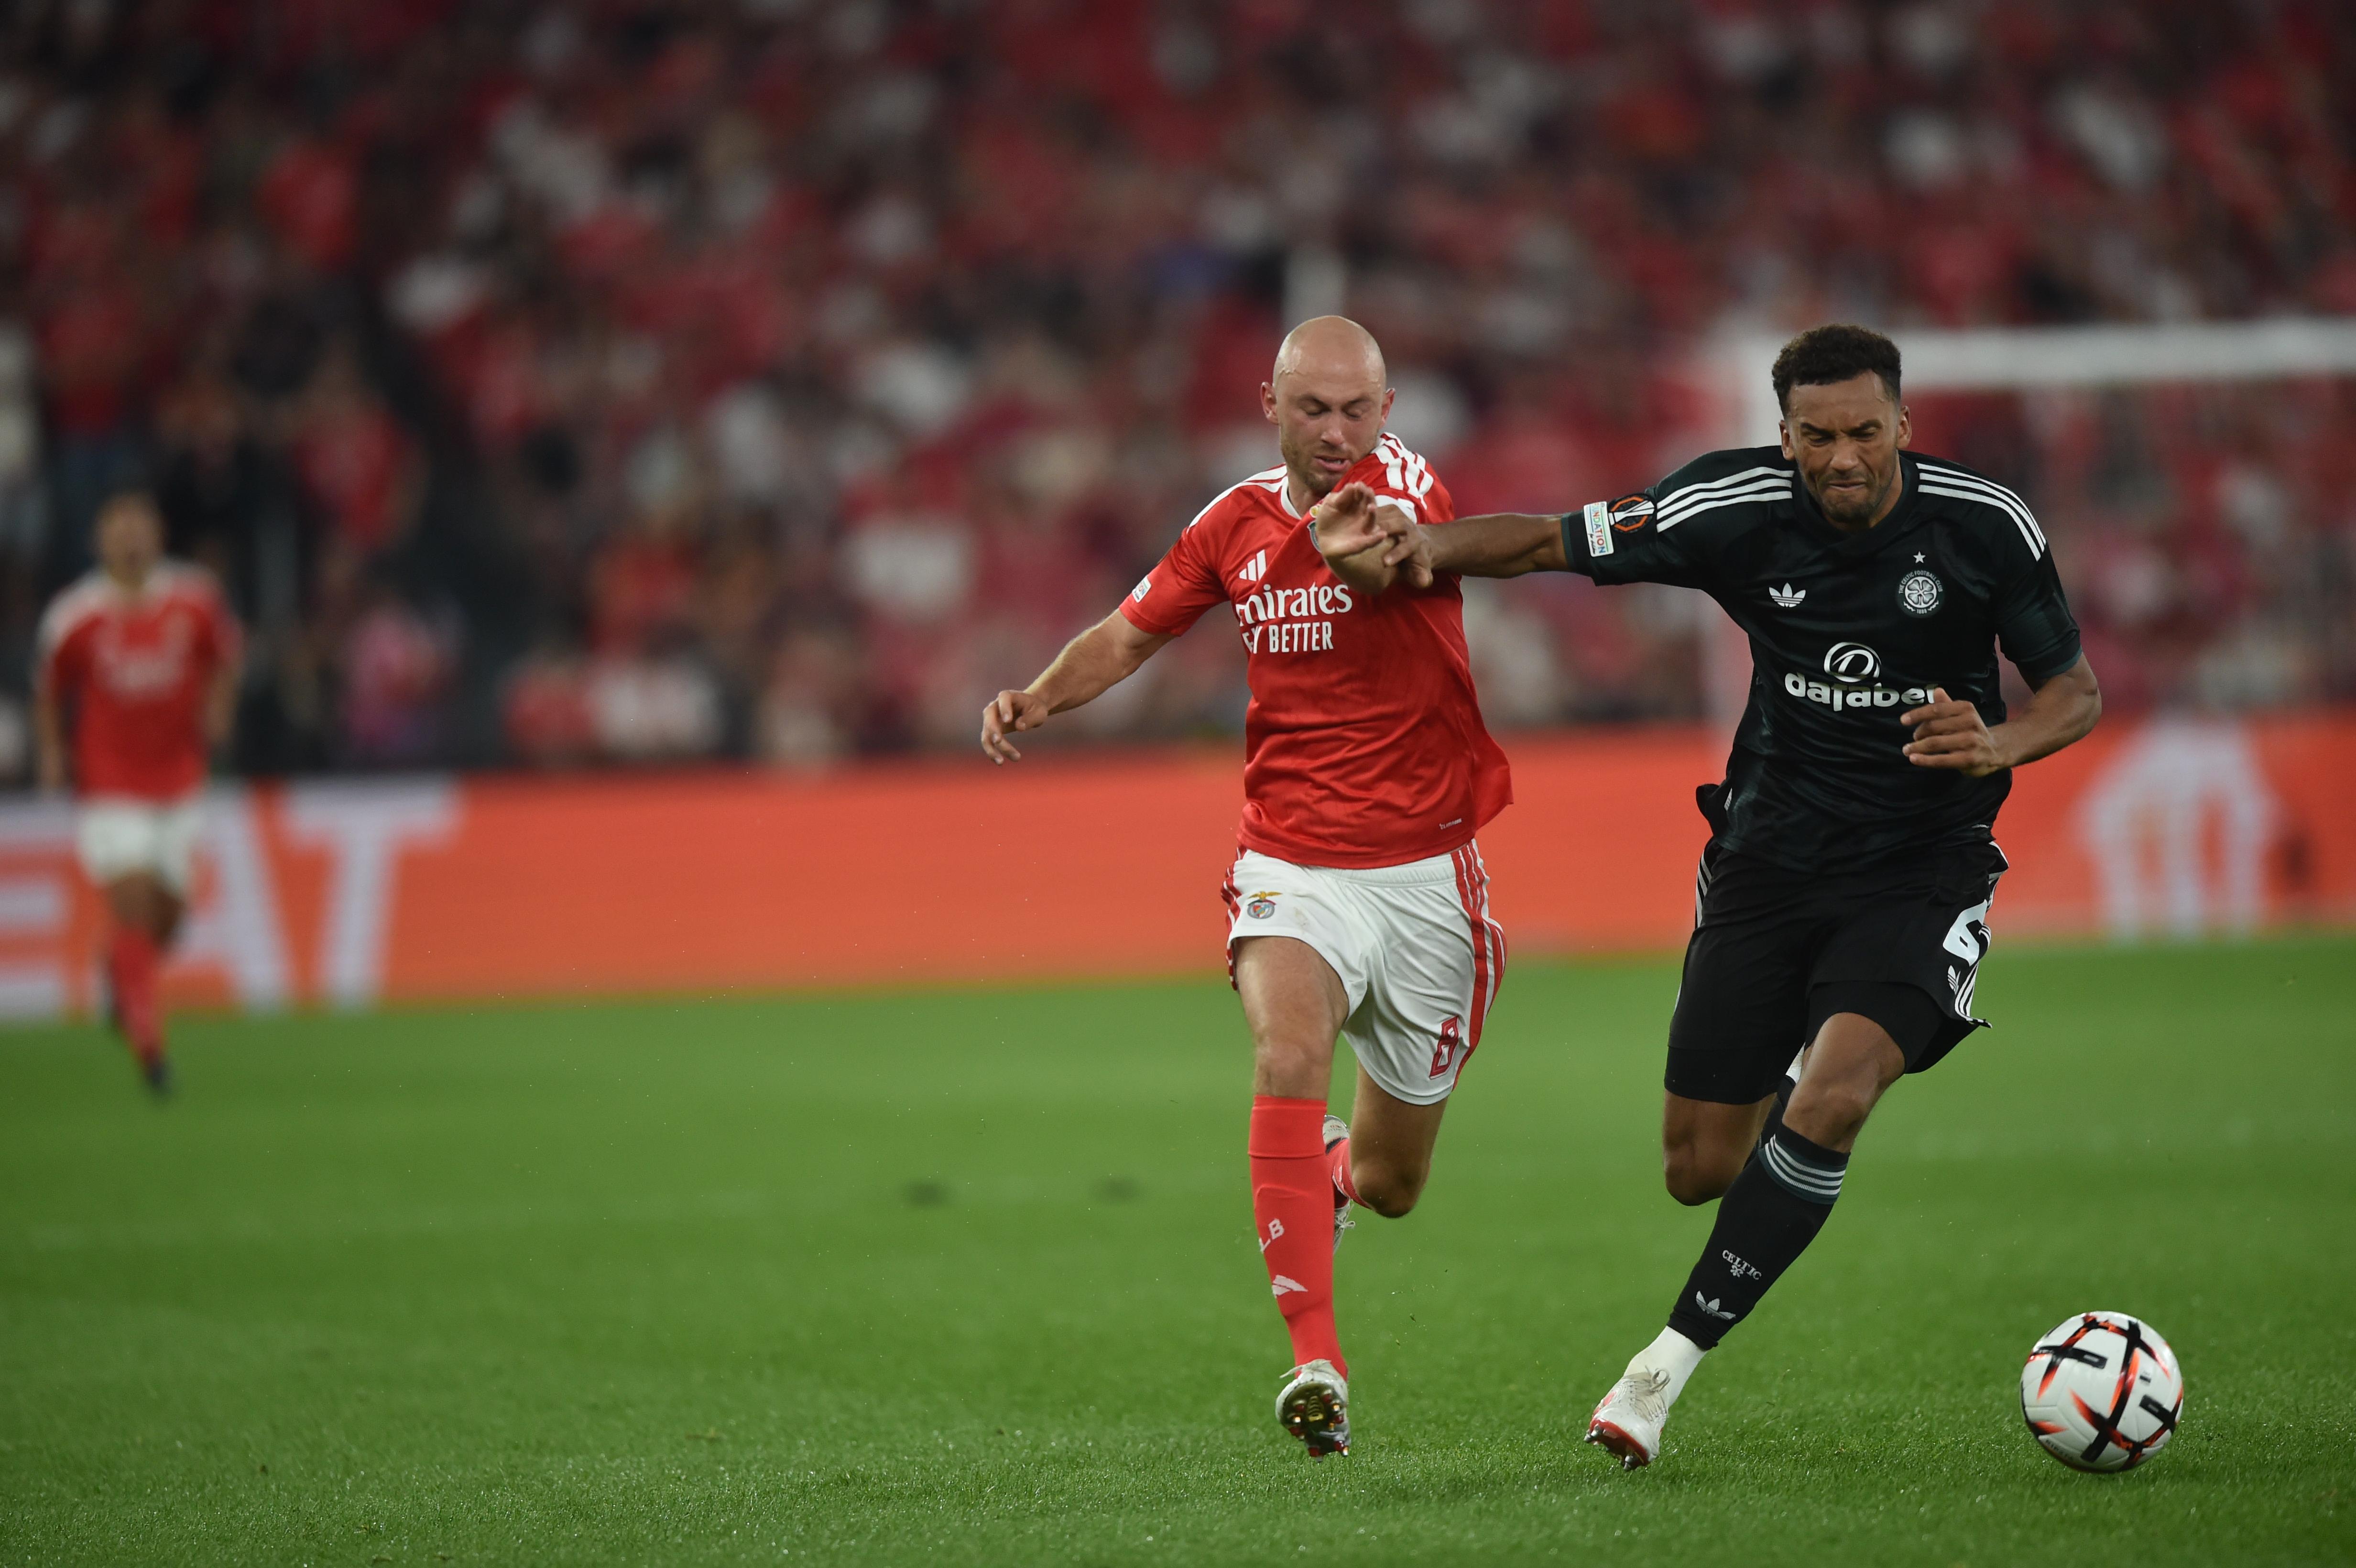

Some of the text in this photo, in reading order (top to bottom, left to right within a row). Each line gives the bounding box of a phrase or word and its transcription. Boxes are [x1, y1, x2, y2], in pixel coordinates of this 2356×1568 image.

[1901, 572, 1914, 585] CELTIC
[1914, 570, 1937, 581] FOOTBALL
[1235, 581, 1353, 627] mirates
[1268, 621, 1333, 653] BETTER
[1942, 899, 1987, 967] 6
[1722, 1250, 1762, 1280] CELTIC
